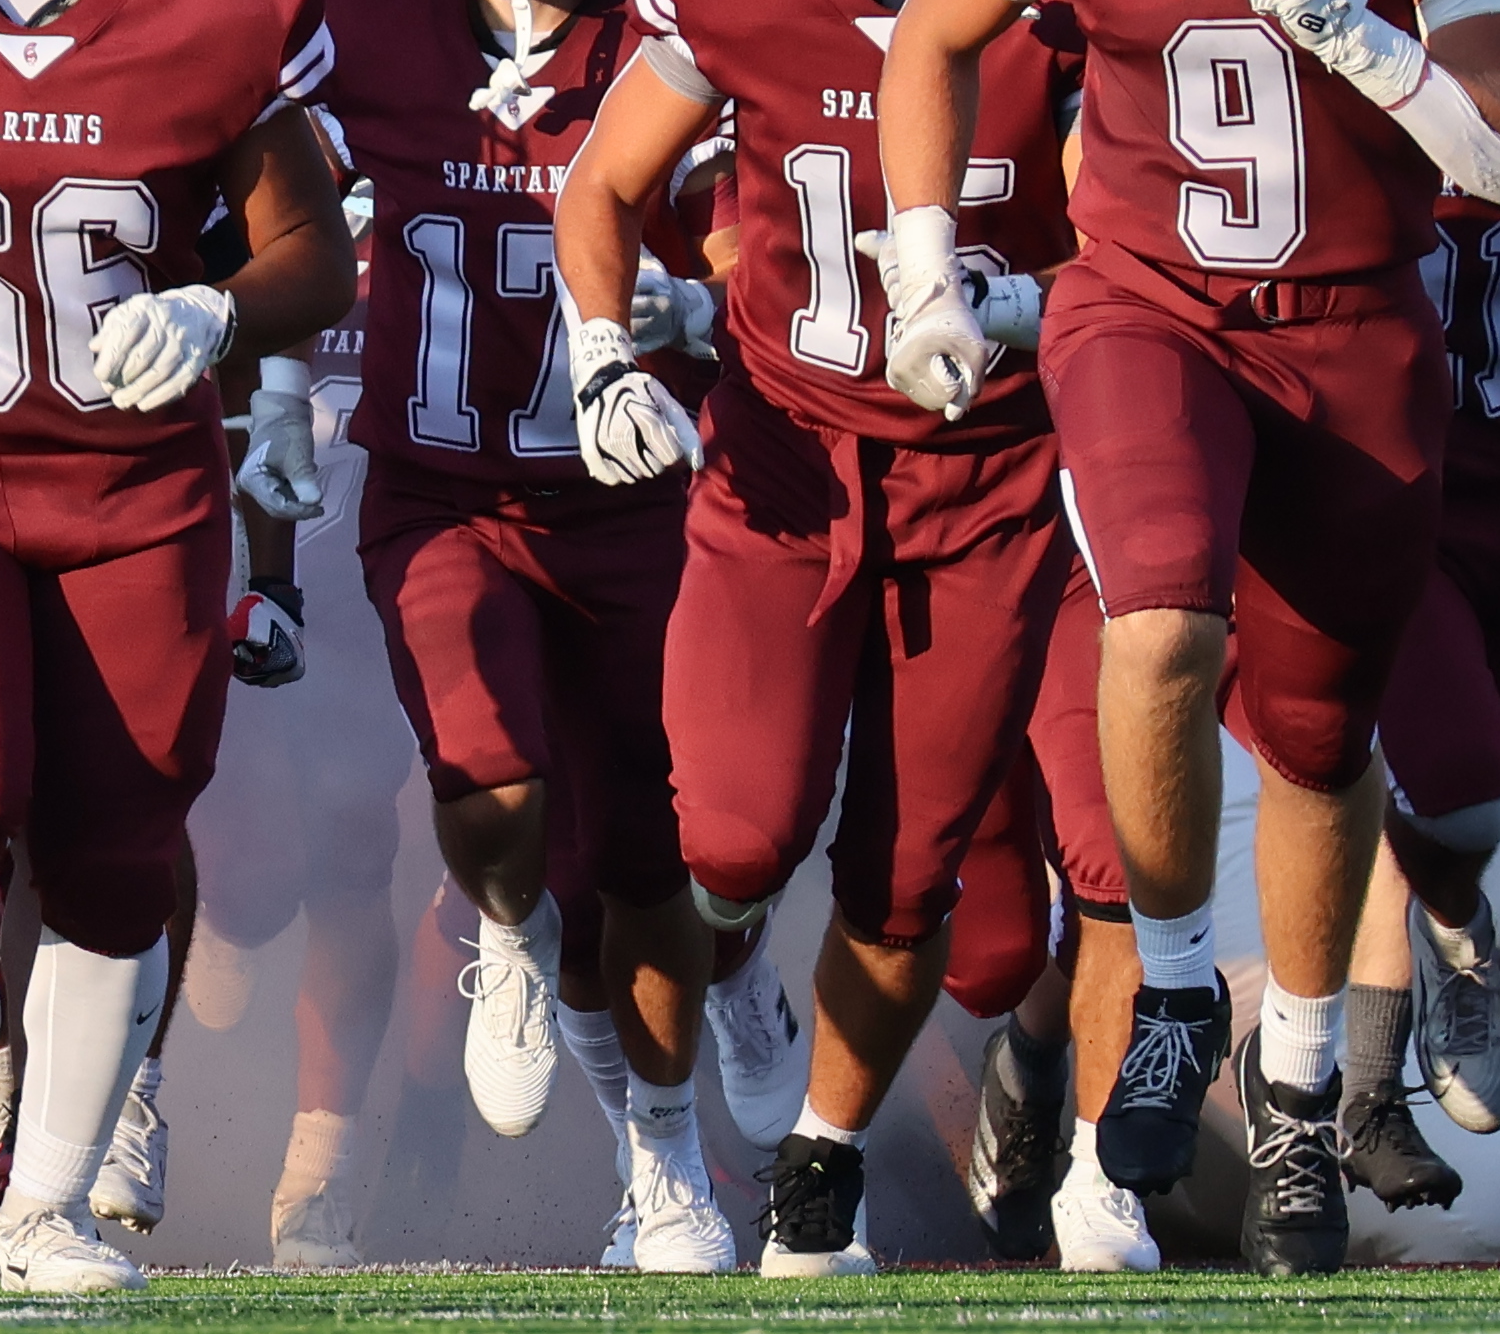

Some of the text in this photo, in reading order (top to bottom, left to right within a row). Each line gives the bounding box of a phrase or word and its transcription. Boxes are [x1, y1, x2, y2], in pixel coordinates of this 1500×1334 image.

[442, 160, 566, 194] SPARTAN
[1162, 18, 1307, 269] 9
[402, 213, 580, 458] 17
